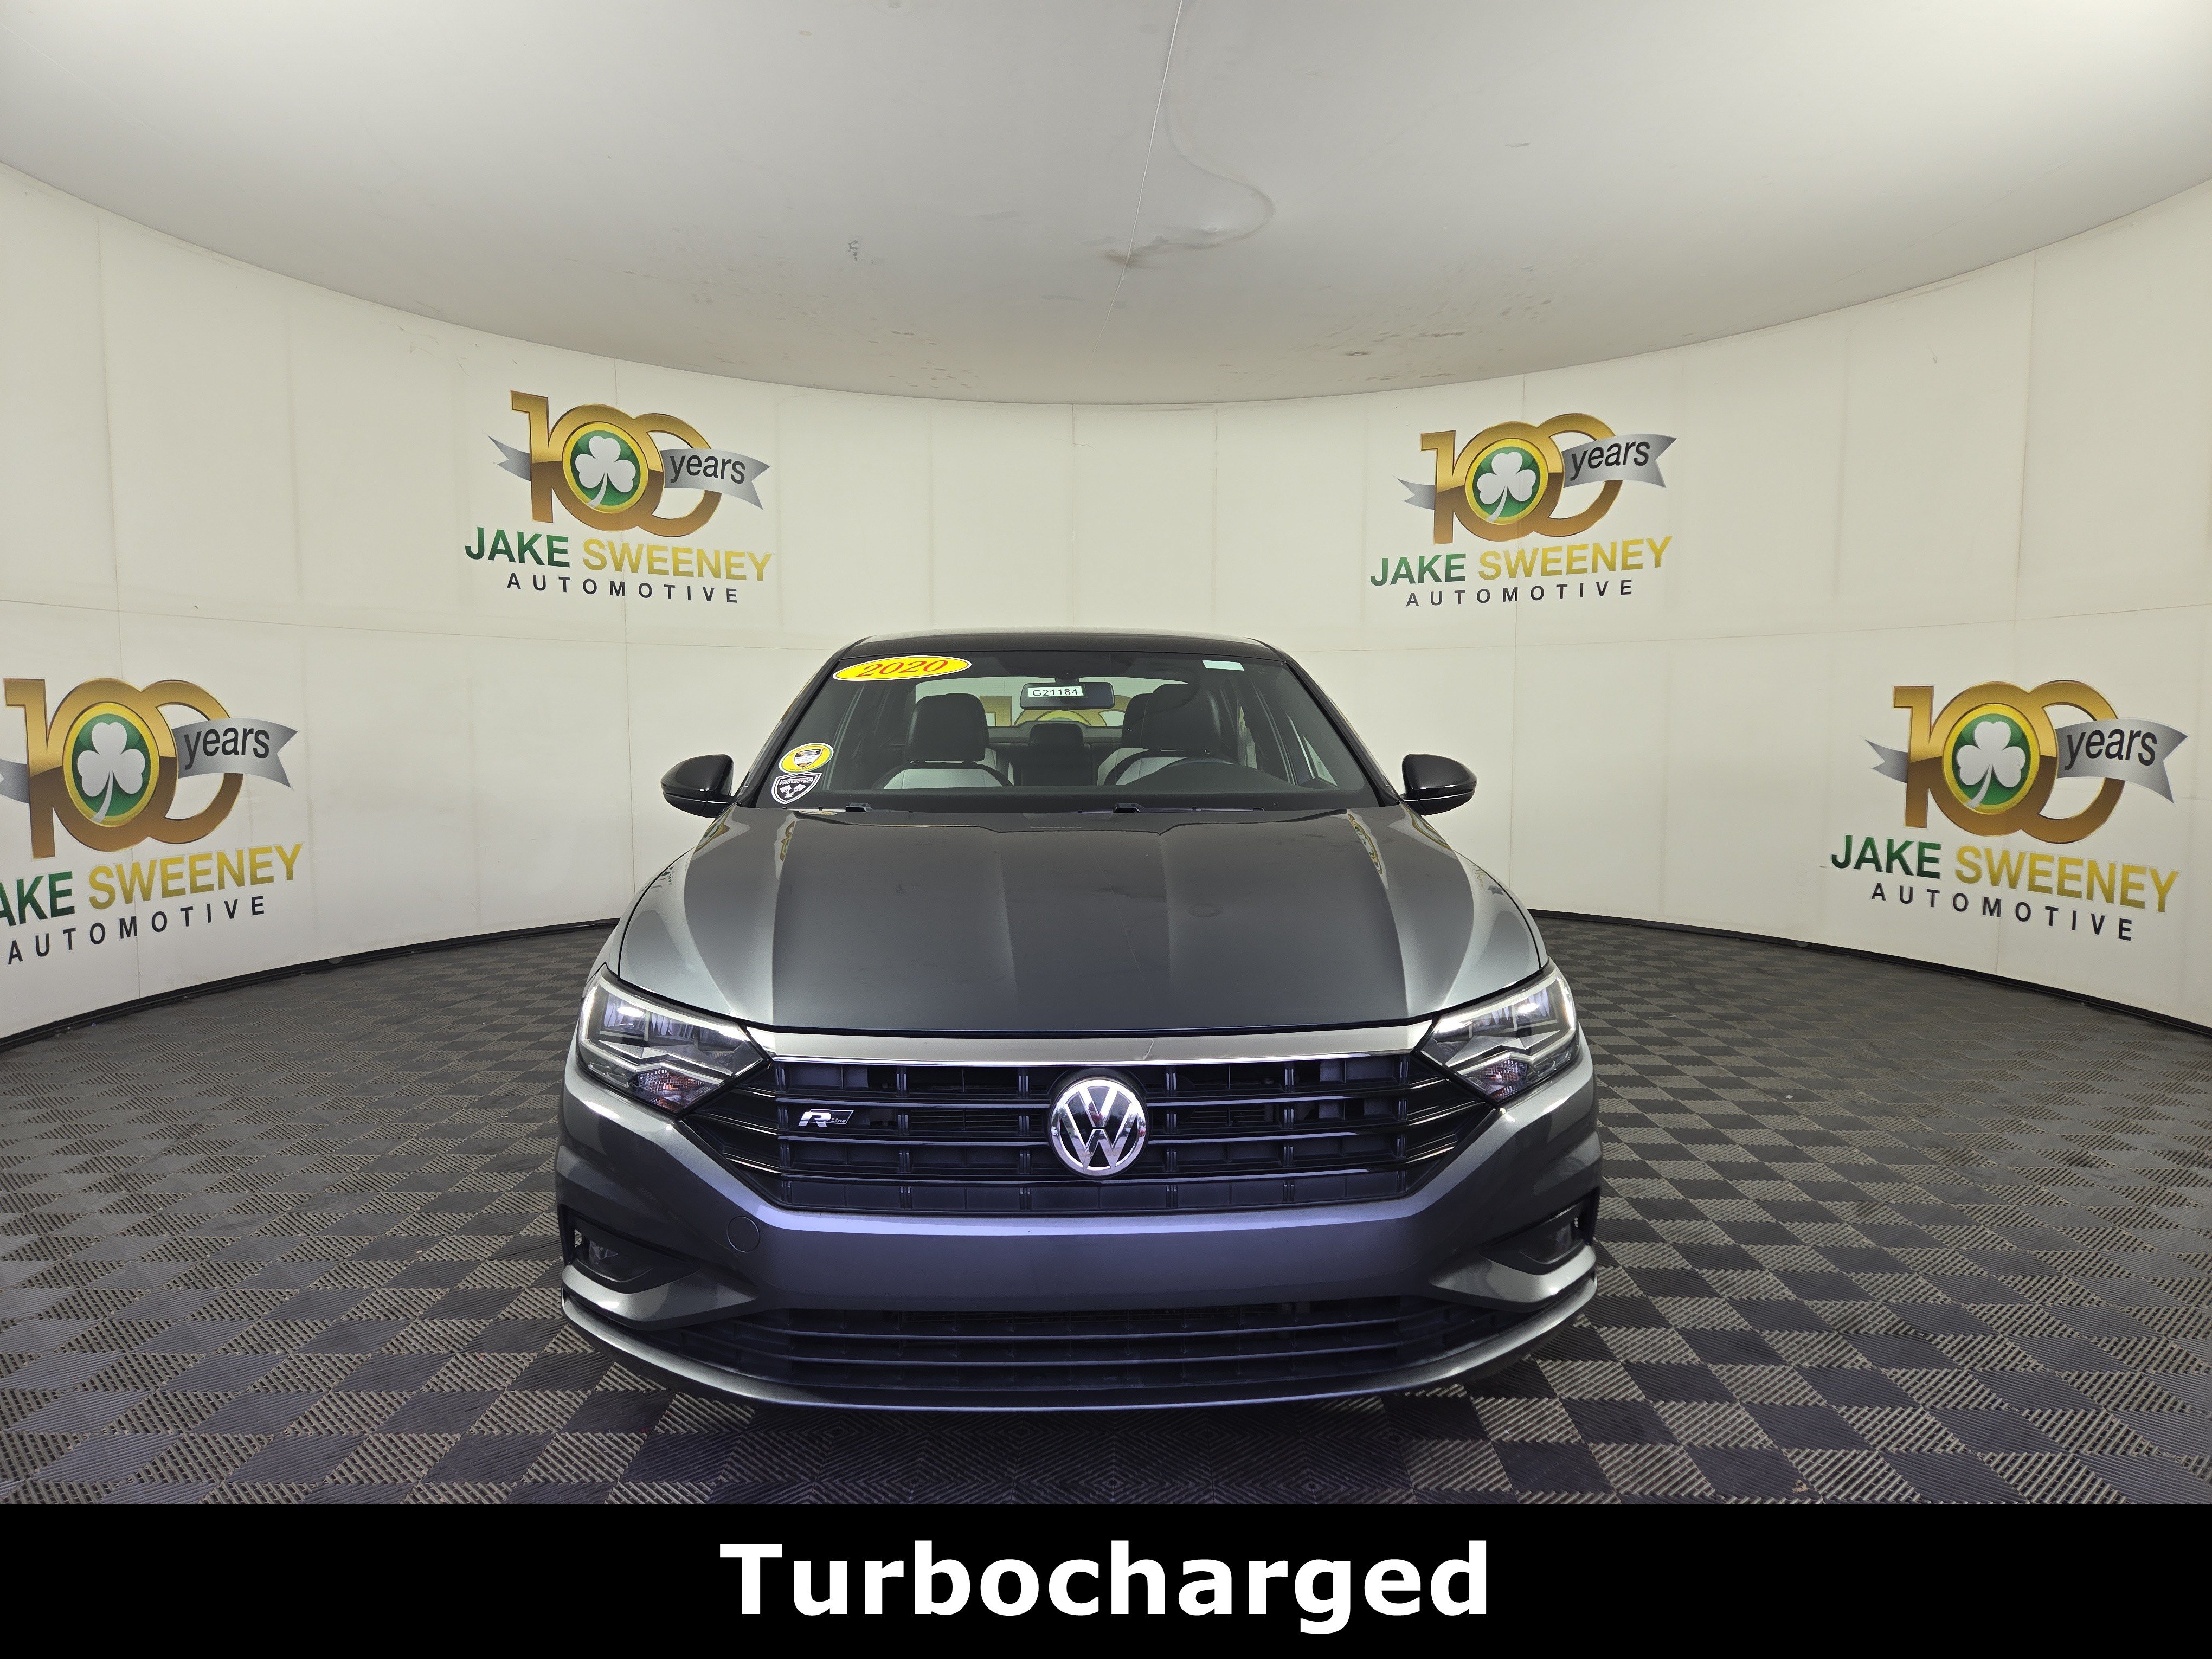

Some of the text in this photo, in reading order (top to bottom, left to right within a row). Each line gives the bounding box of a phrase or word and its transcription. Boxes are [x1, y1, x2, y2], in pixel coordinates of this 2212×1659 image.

[511, 390, 746, 537] 100 years
[1420, 413, 1650, 544] 100 years
[465, 526, 772, 581] JAKE SWEENEY
[1370, 536, 1673, 586] JAKE SWEENEY
[507, 573, 737, 603] AUTOMOTIVE
[1406, 579, 1632, 607] AUTOMOTIVE
[854, 660, 948, 678] 2020
[1032, 688, 1079, 697] G21184
[3, 678, 270, 858] 100 years
[1893, 680, 2158, 844] 100 years
[0, 843, 303, 927] AKE SWEENEY
[1831, 835, 2179, 913] JAKE SWEENEY
[8, 896, 265, 964] AUTOMOTIVE
[1871, 883, 2132, 941] AUTOMOTIVE
[798, 1111, 827, 1128] R
[1055, 1082, 1142, 1172] VW
